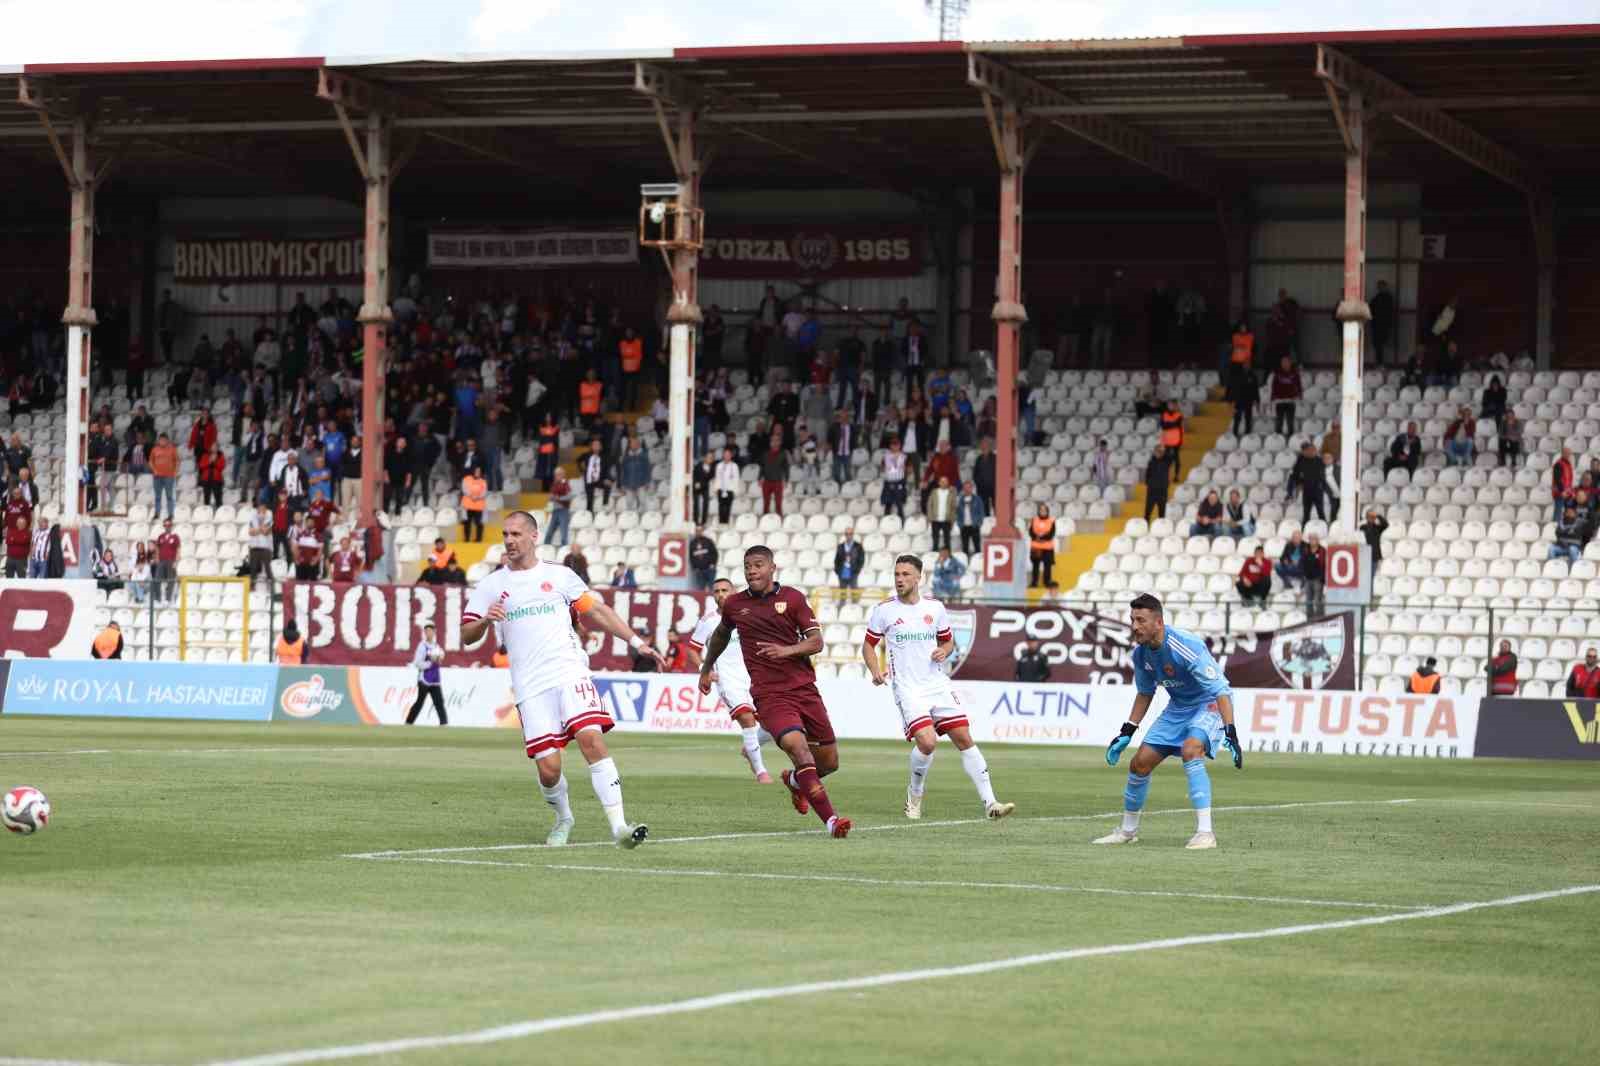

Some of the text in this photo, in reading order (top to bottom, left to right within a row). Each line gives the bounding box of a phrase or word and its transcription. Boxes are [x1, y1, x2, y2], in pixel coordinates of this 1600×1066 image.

[702, 239, 790, 261] FORZA
[845, 240, 911, 261] 1965
[61, 532, 77, 563] A
[662, 541, 682, 575] S
[987, 545, 1009, 578] P
[53, 679, 139, 704] ROYAL
[575, 683, 596, 699] 44
[991, 690, 1091, 717] ALTIN
